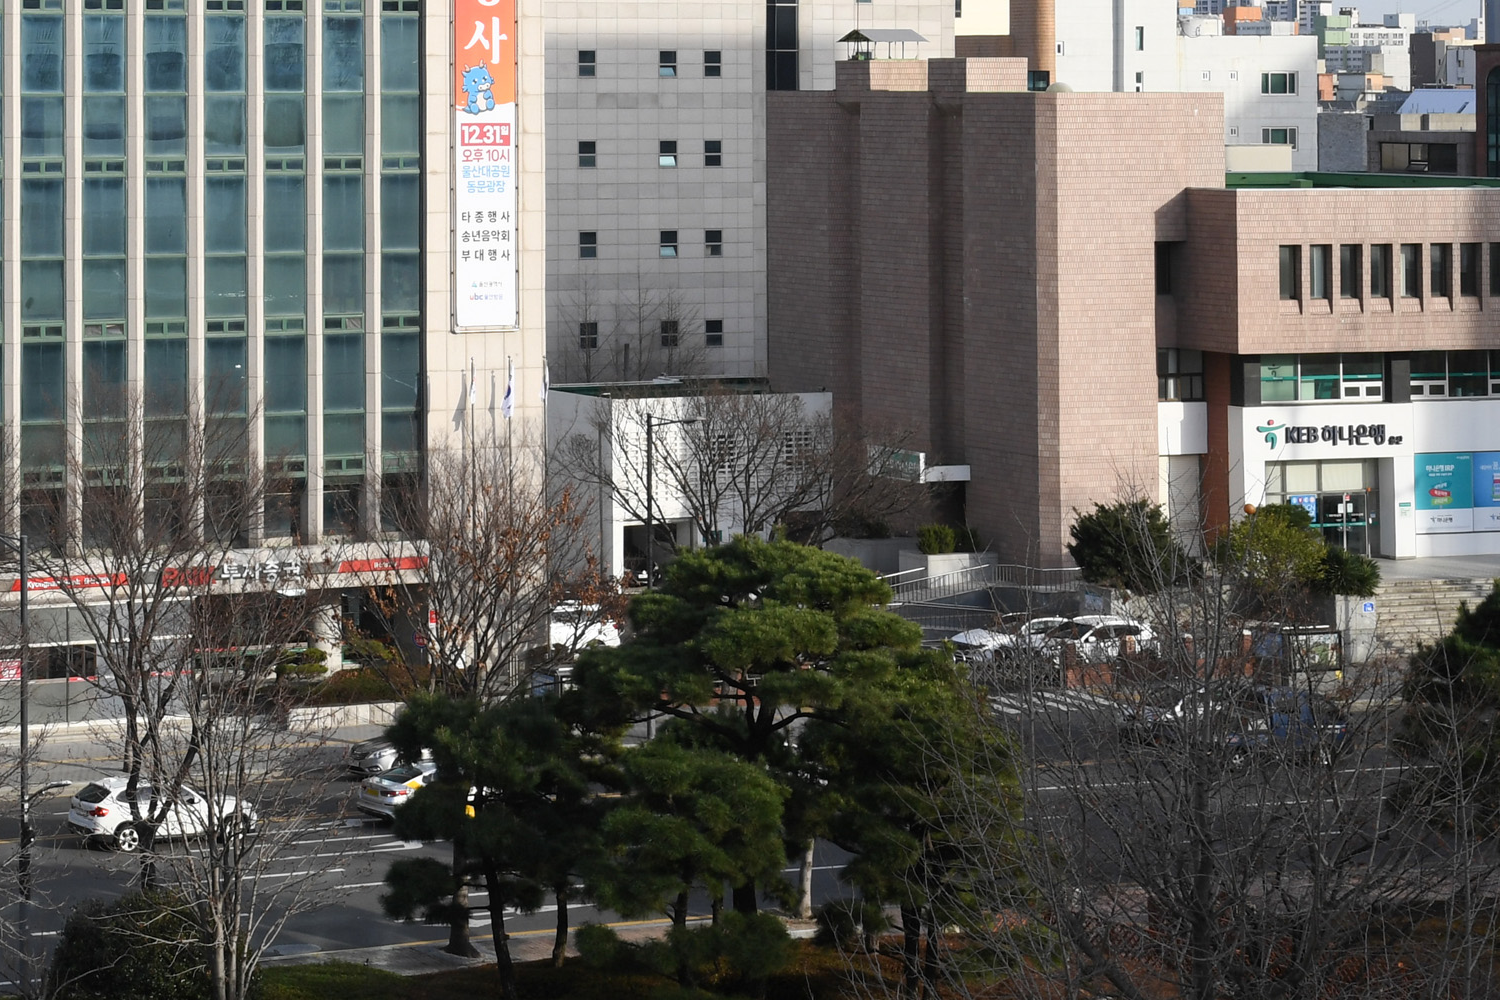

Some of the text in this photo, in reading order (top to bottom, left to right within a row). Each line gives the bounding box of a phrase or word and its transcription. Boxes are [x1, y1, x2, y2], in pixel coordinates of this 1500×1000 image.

[462, 148, 510, 163] 오후 10시
[462, 165, 510, 179] 울산대공원
[466, 180, 506, 193] 동문광장
[461, 230, 510, 243] 송년음악회
[1284, 425, 1320, 445] KEB
[1320, 424, 1386, 447] 하나은행
